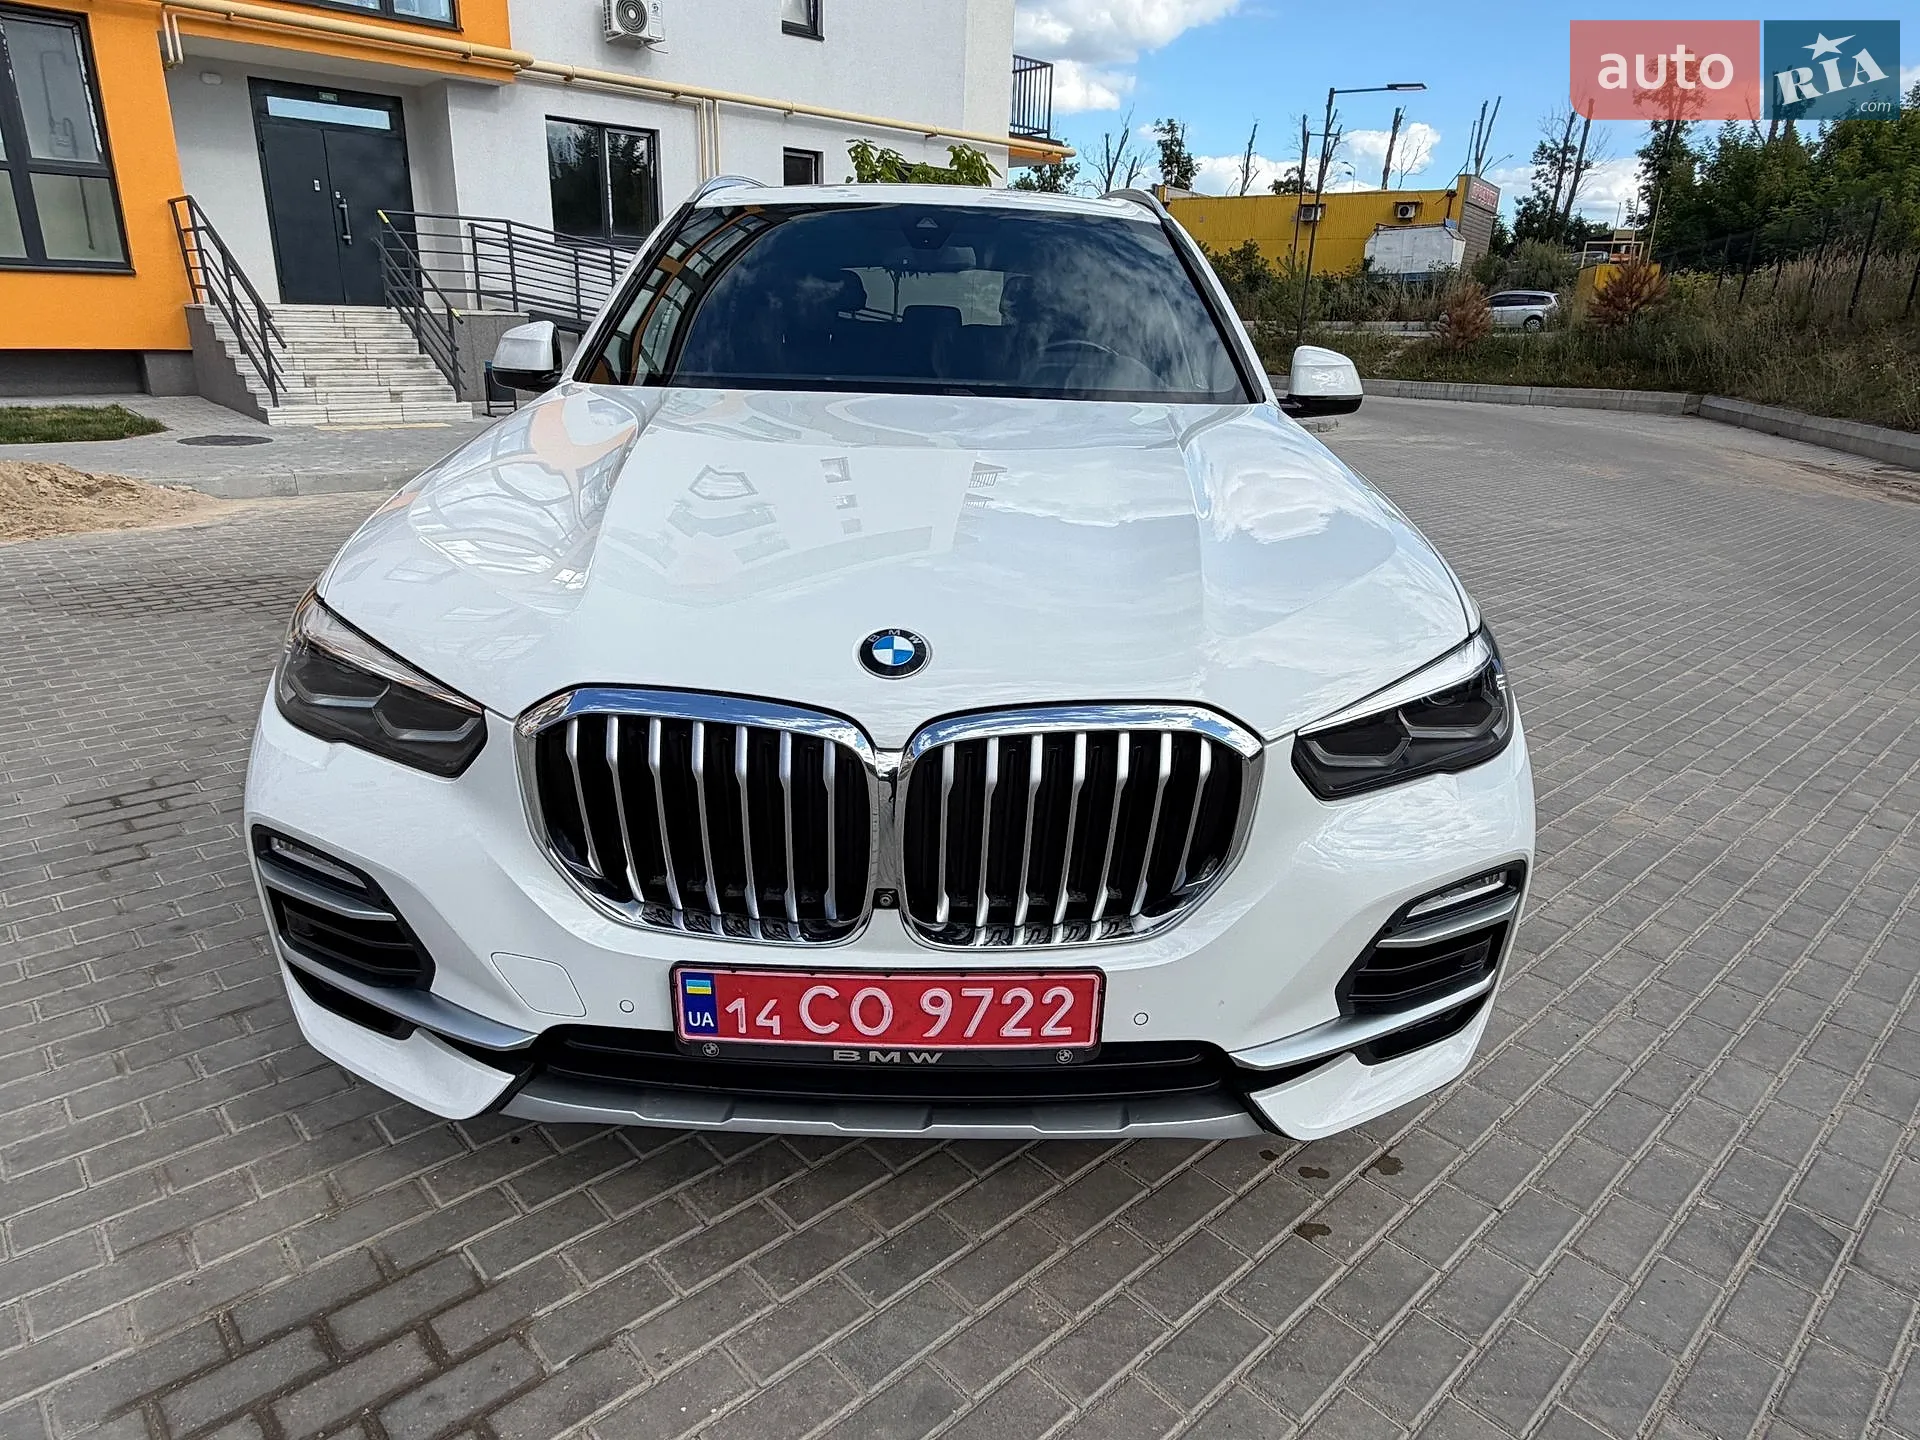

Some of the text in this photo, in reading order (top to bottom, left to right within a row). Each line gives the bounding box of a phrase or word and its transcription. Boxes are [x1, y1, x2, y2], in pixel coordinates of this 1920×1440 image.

[868, 629, 922, 644] BMW
[688, 1011, 714, 1027] UA
[725, 985, 1075, 1038] 14 CO 9722
[833, 1049, 943, 1064] BMW
